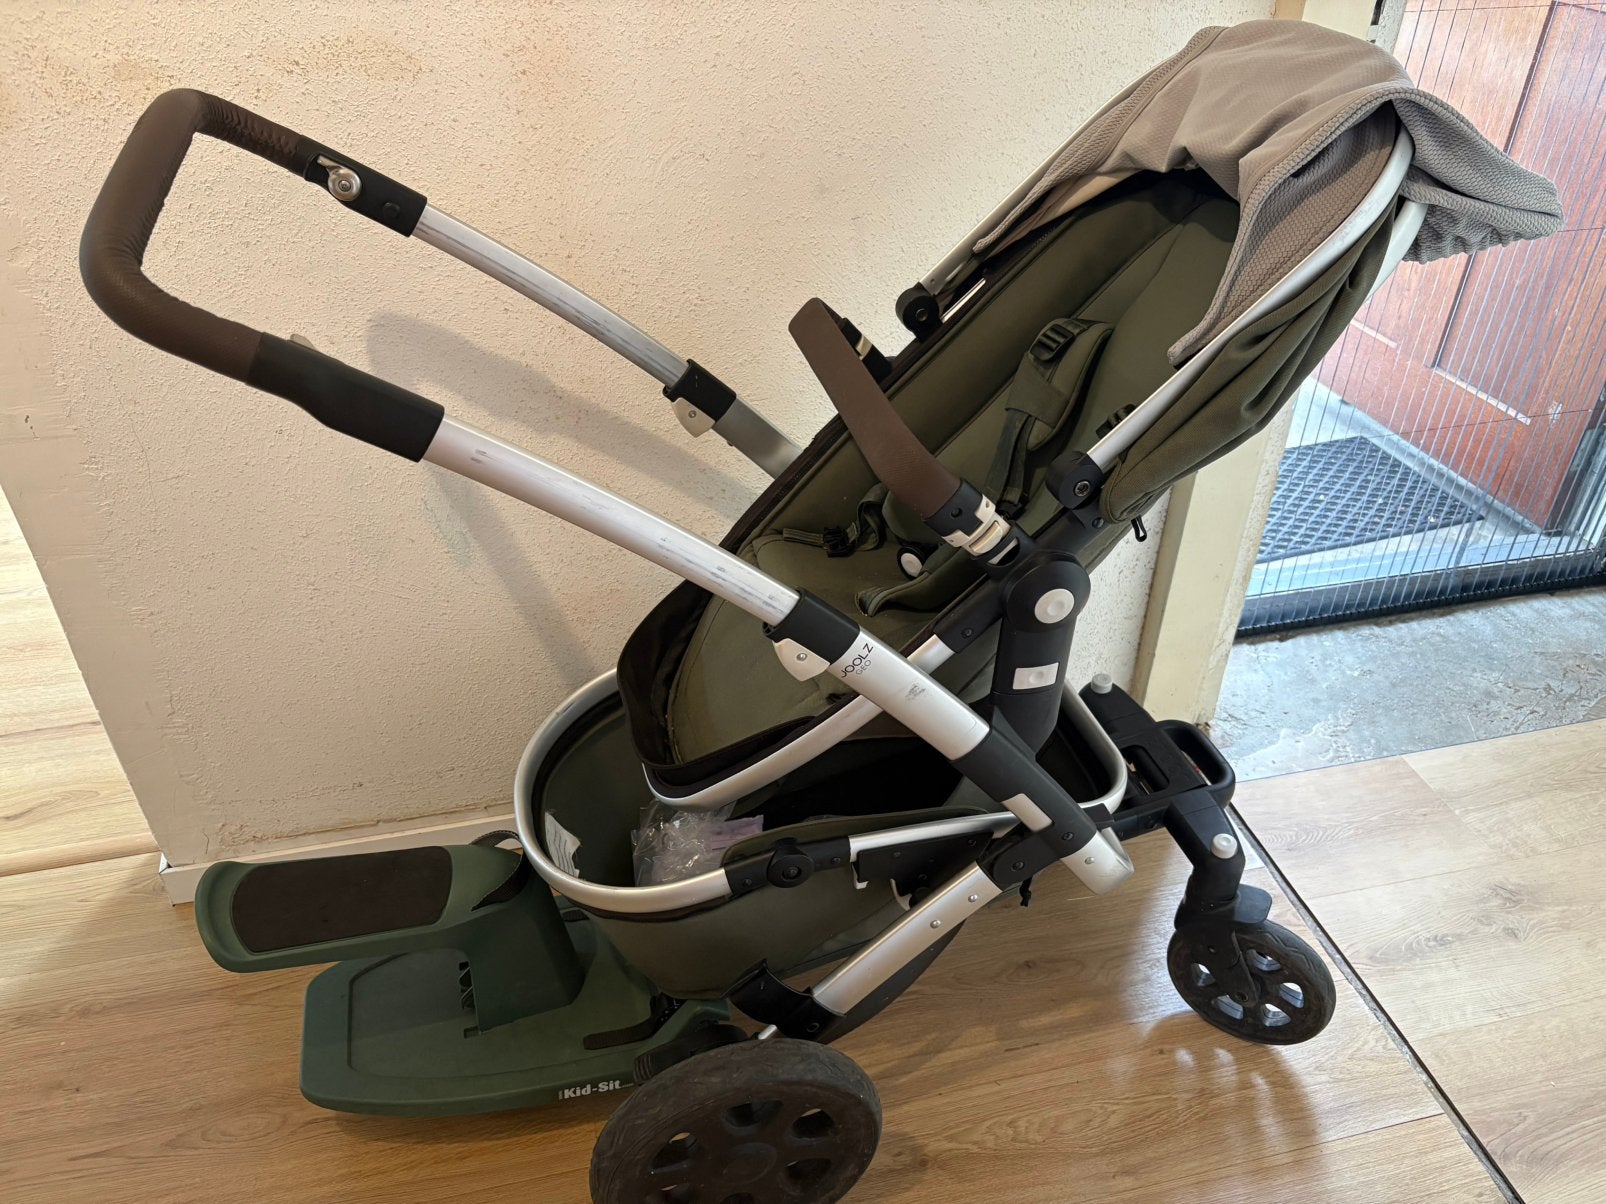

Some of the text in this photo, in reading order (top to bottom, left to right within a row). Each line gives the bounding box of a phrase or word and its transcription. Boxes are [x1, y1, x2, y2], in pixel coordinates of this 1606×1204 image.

[841, 643, 874, 678] JOOLZ
[856, 660, 872, 675] GEO
[563, 1080, 621, 1099] Kid-Sit
